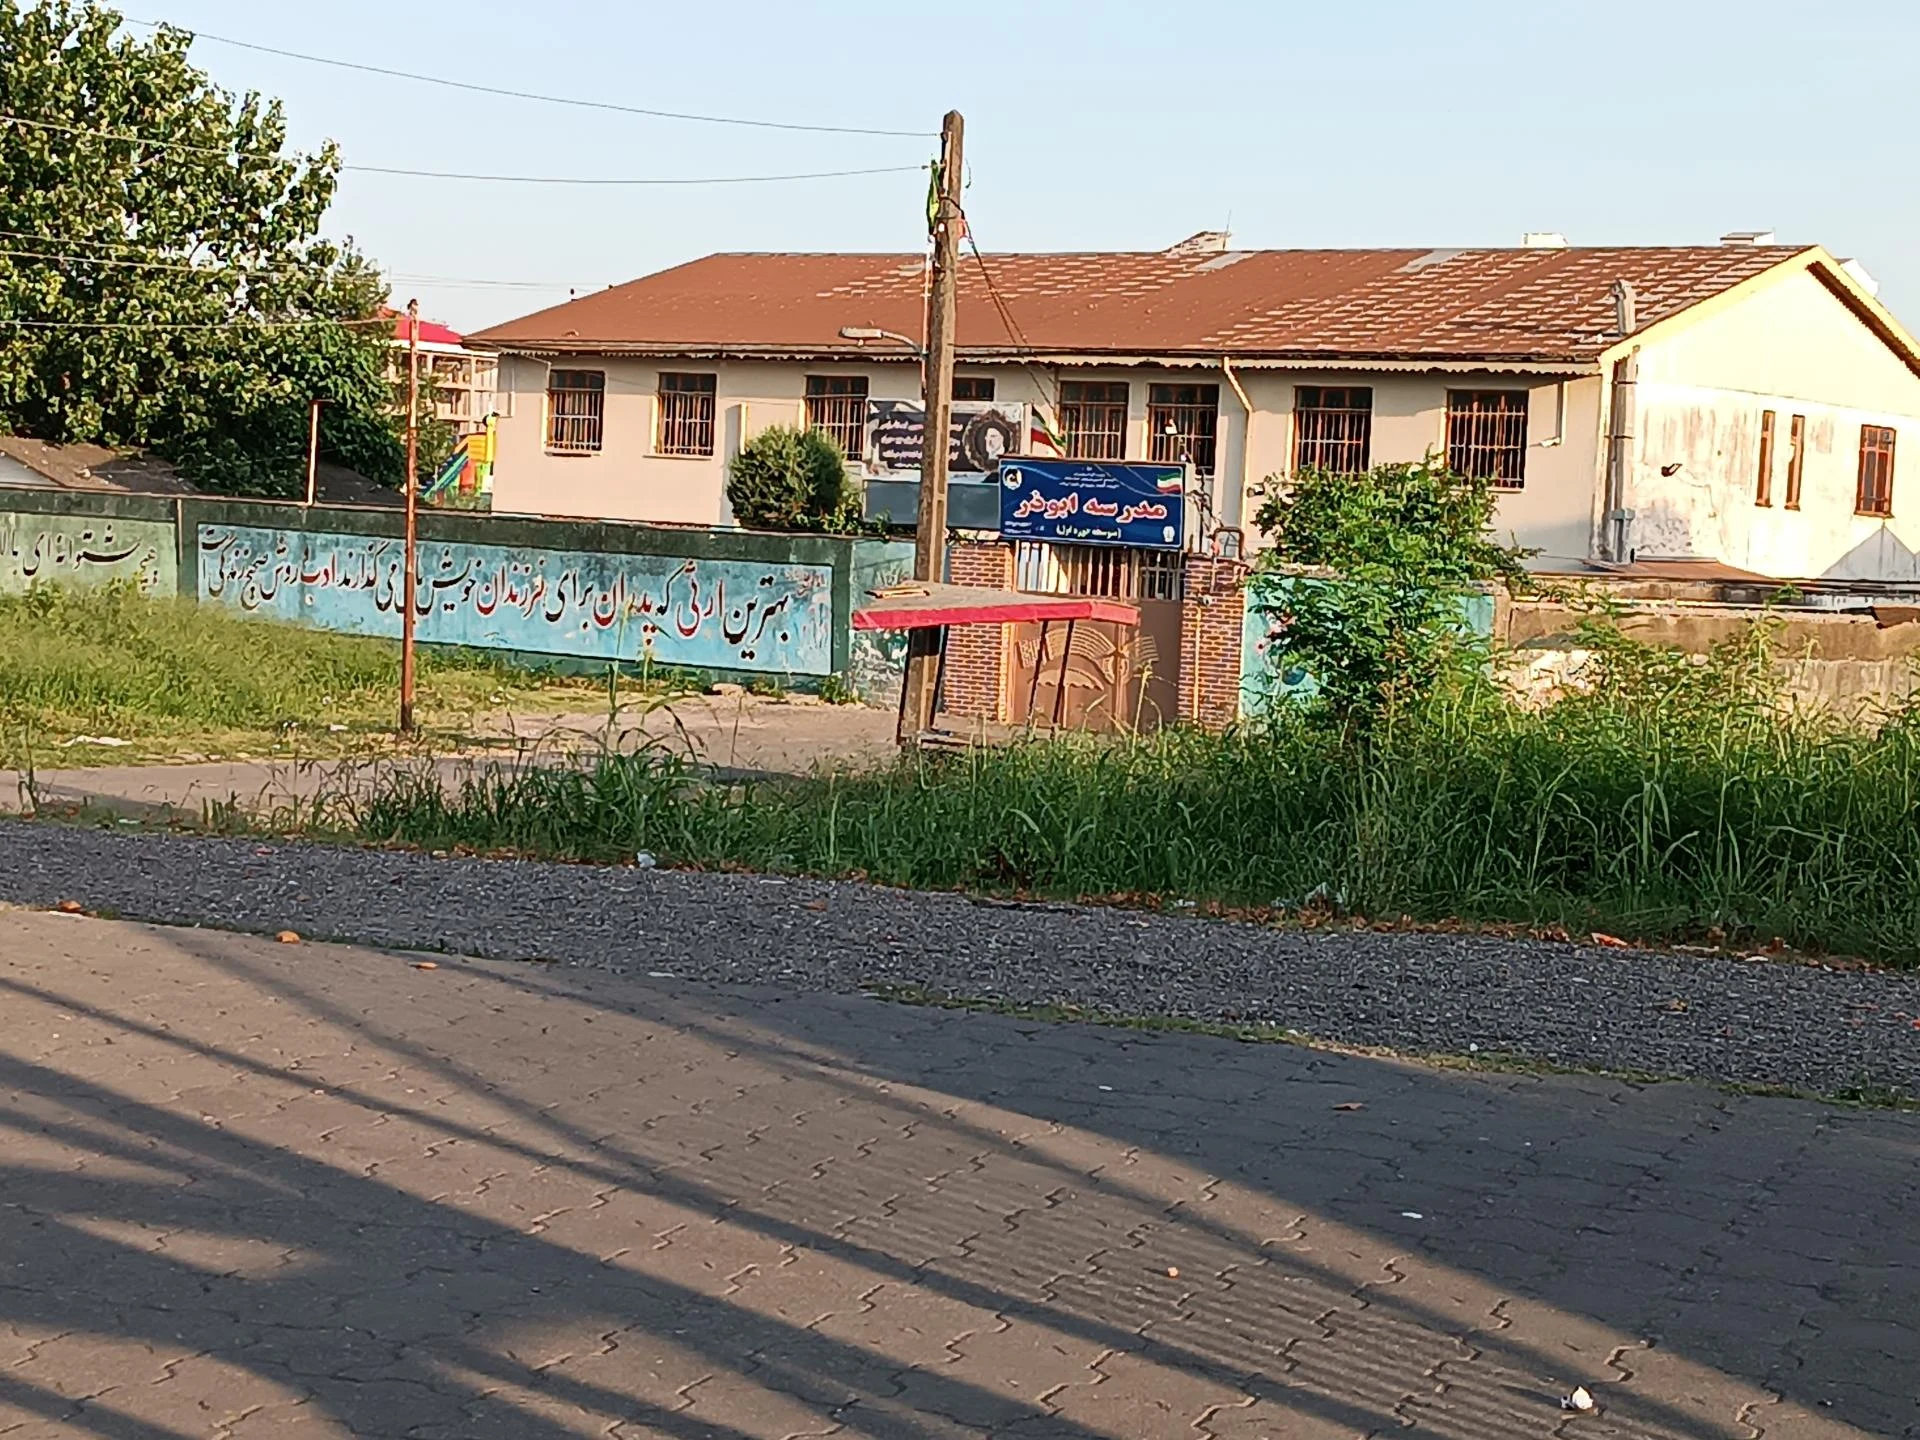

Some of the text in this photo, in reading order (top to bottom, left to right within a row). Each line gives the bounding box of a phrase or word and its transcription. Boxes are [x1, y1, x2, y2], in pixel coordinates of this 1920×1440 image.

[1013, 490, 1168, 524] مدرسه ابوذر
[415, 549, 482, 616] خویش
[477, 558, 545, 618] فرزندان
[545, 568, 594, 630] برای
[723, 575, 791, 661] بهترین
